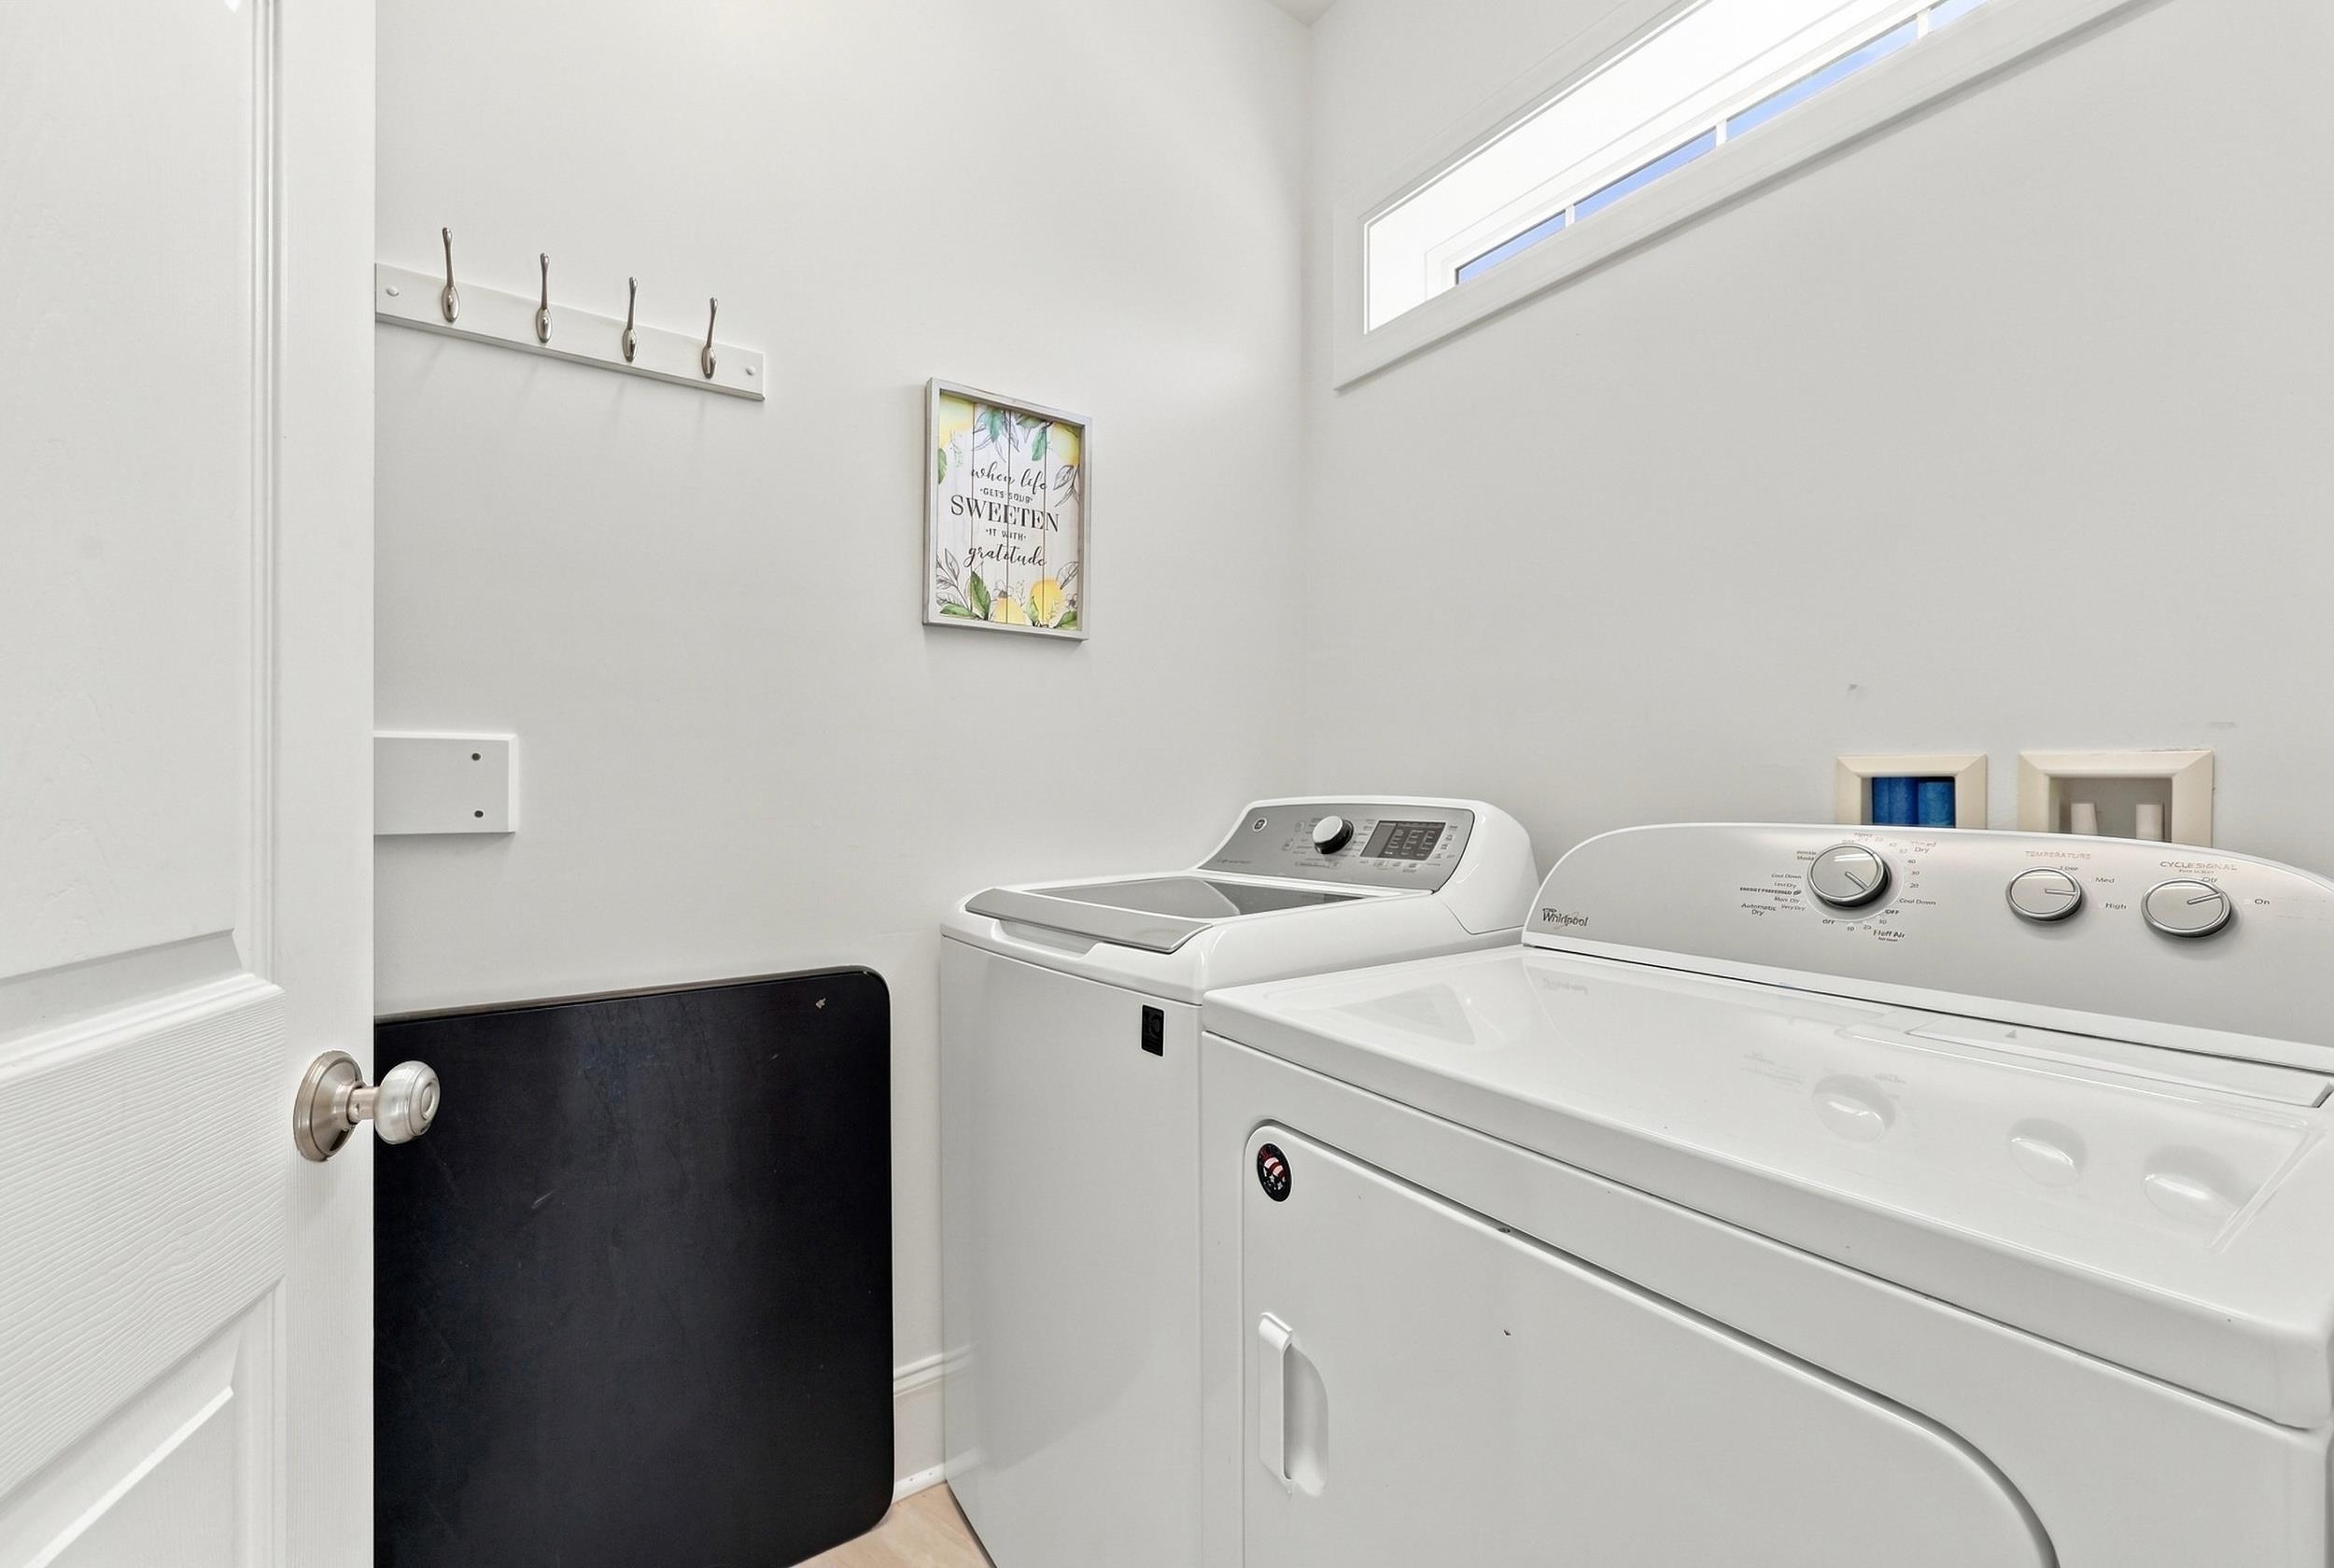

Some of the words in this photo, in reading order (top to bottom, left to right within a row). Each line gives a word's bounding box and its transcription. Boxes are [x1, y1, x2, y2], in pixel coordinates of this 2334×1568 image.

[971, 461, 1015, 484] when
[1020, 468, 1047, 495] life
[983, 487, 1005, 498] GETS
[950, 494, 1060, 533] SWEETEN
[988, 527, 997, 537] IT
[1001, 530, 1024, 541] WITH
[963, 543, 1047, 568] gratitude
[2024, 850, 2091, 860] TEMPERATURE
[2159, 861, 2194, 869] CYCLE
[2195, 862, 2238, 871] SIGNAL
[1740, 903, 1777, 912] Automatic
[1750, 908, 1765, 917] Dry
[1542, 912, 1589, 927] Whirlpool
